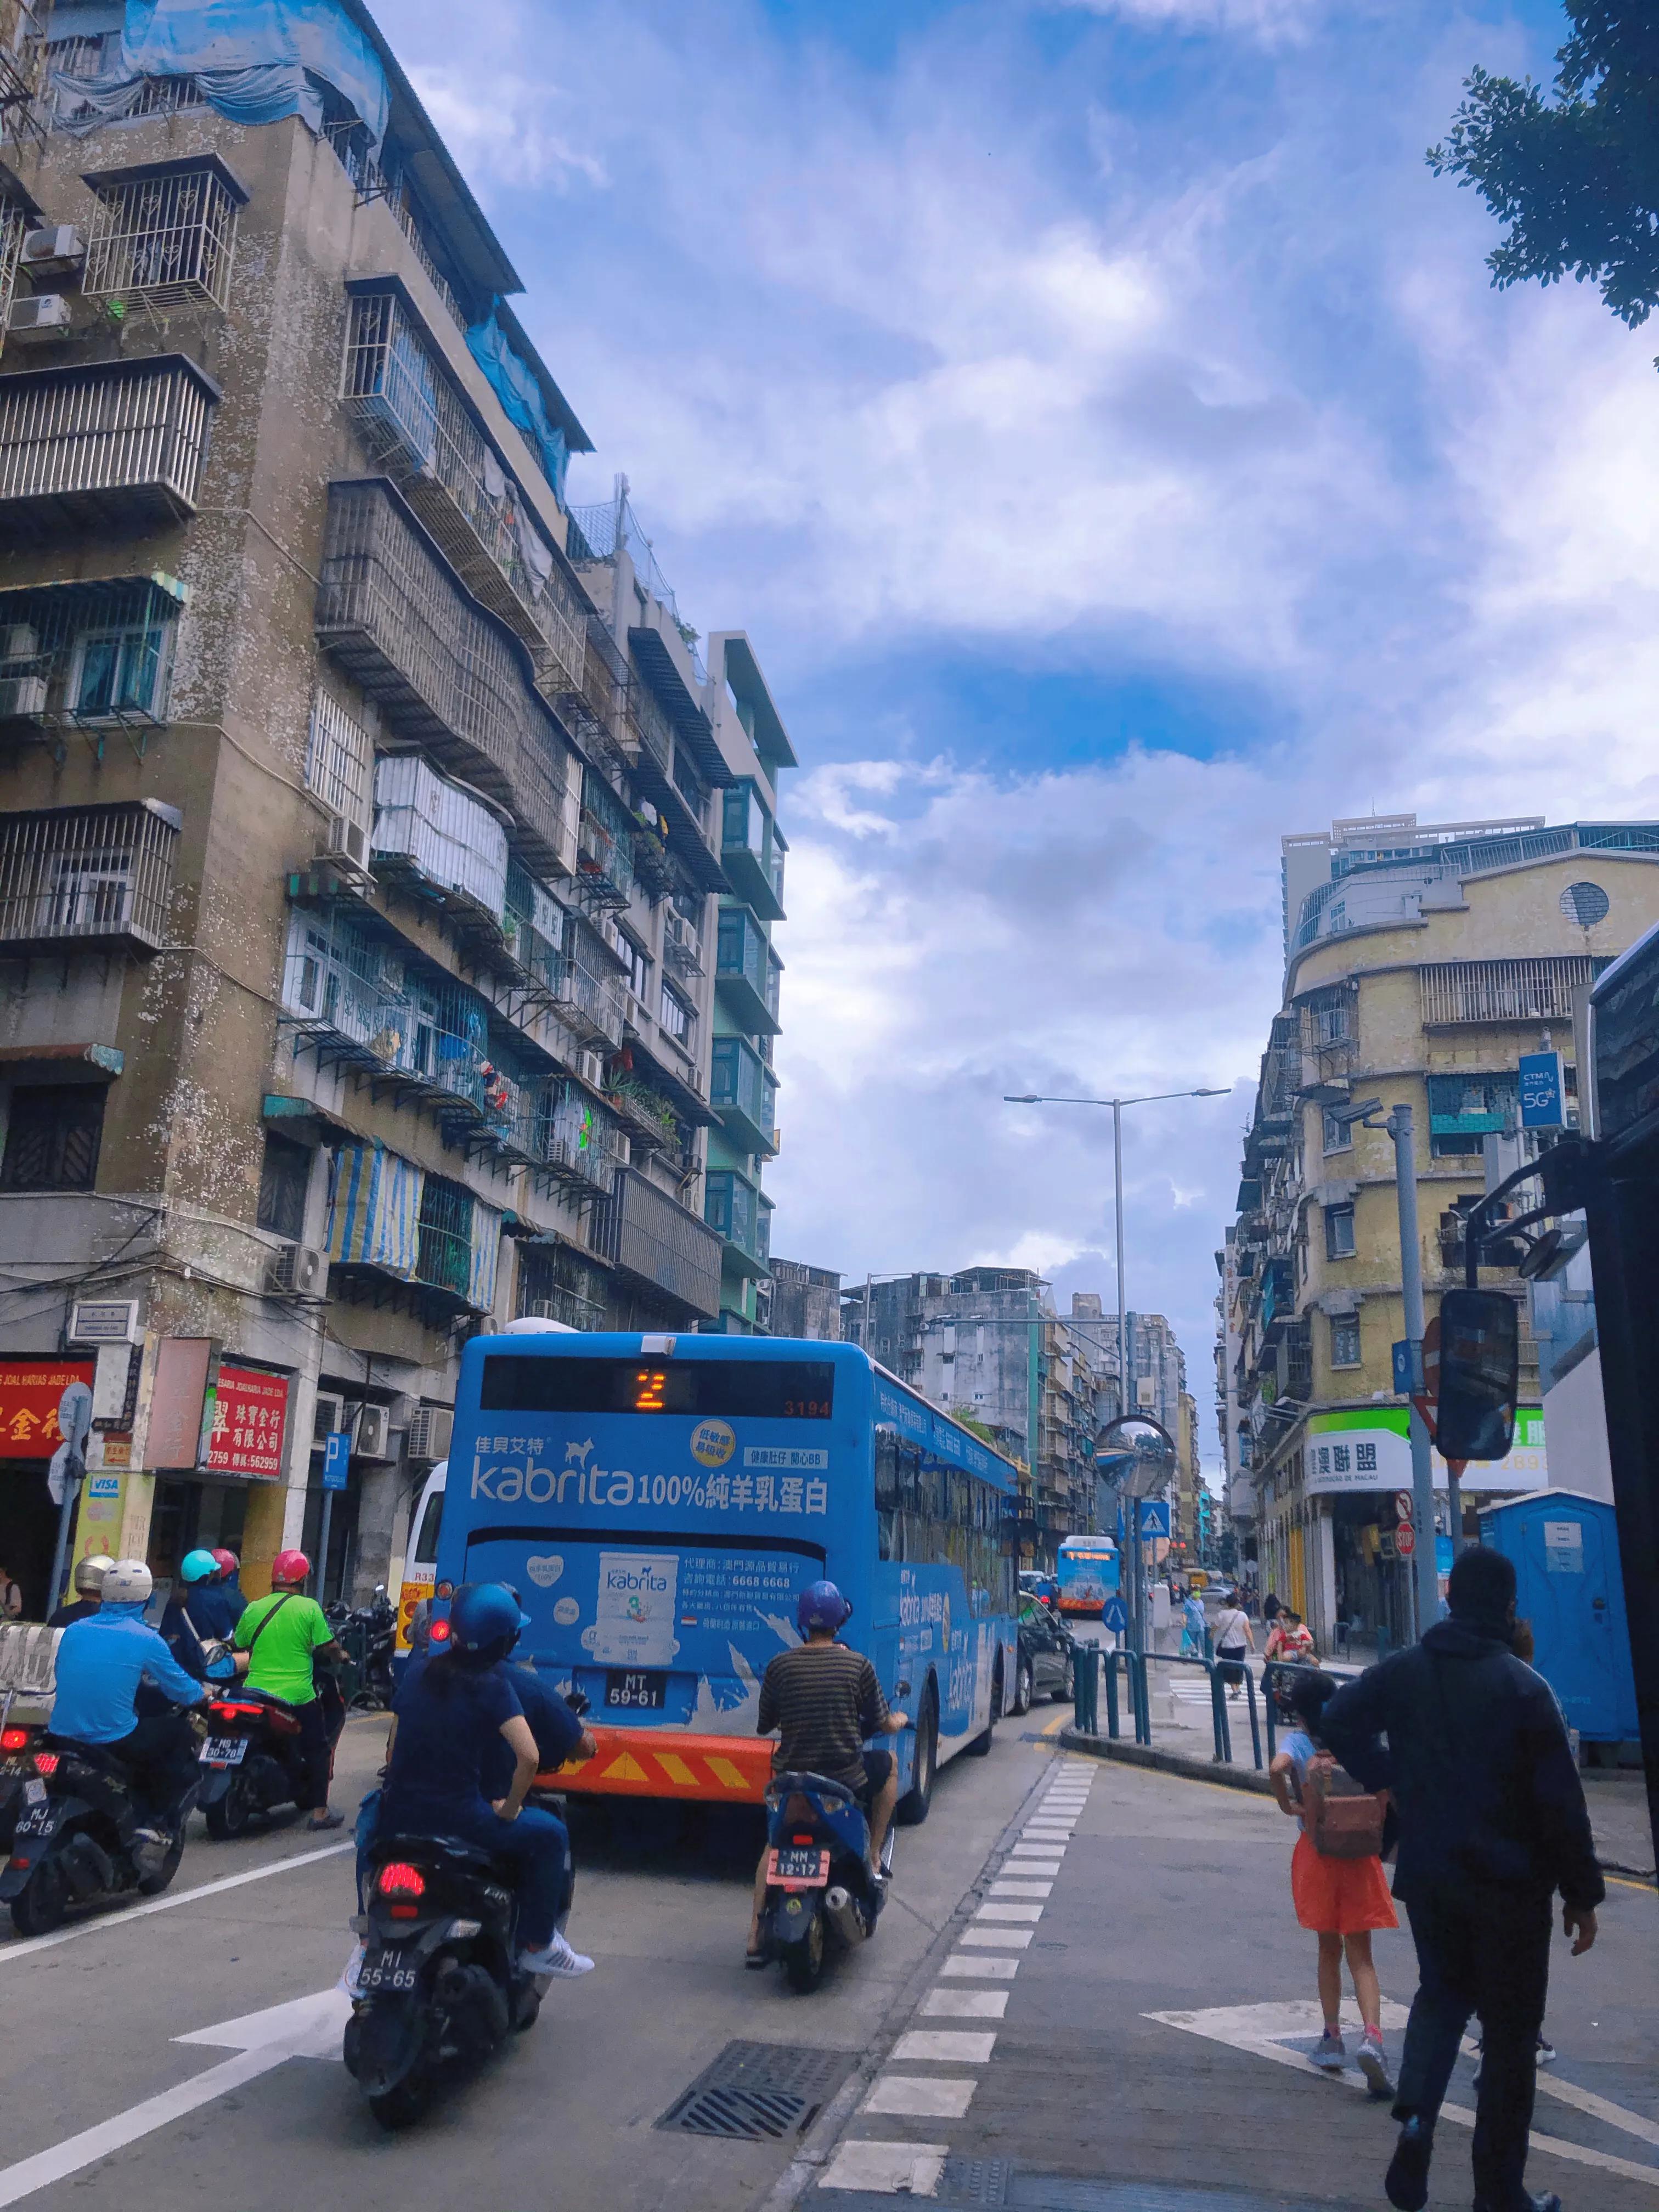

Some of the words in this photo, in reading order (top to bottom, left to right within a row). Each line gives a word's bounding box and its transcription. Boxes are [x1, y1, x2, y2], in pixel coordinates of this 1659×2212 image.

[1523, 1092, 1549, 1108] 5G
[235, 1403, 281, 1430] 珠寶金行
[784, 1400, 830, 1417] 3194
[233, 1427, 278, 1453] 有限公司
[475, 1436, 544, 1455] 佳貝艾特
[208, 1450, 229, 1464] 2759
[325, 1436, 339, 1472] P
[751, 1449, 787, 1464] 健康肚仔
[95, 1479, 119, 1489] VISA
[471, 1454, 634, 1506] kabrita
[637, 1474, 828, 1515] 100%純羊乳蛋白
[1395, 1531, 1414, 1547] STOP
[415, 1572, 435, 1582] R33
[607, 1571, 667, 1591] kabrita
[763, 1576, 790, 1589] 6668
[625, 1673, 647, 1690] MT
[610, 1688, 657, 1707] 59-61
[30, 1808, 49, 1820] MJ
[15, 1820, 54, 1835] 60-15
[381, 1950, 402, 1968] MI
[360, 1967, 416, 1989] 55-65
